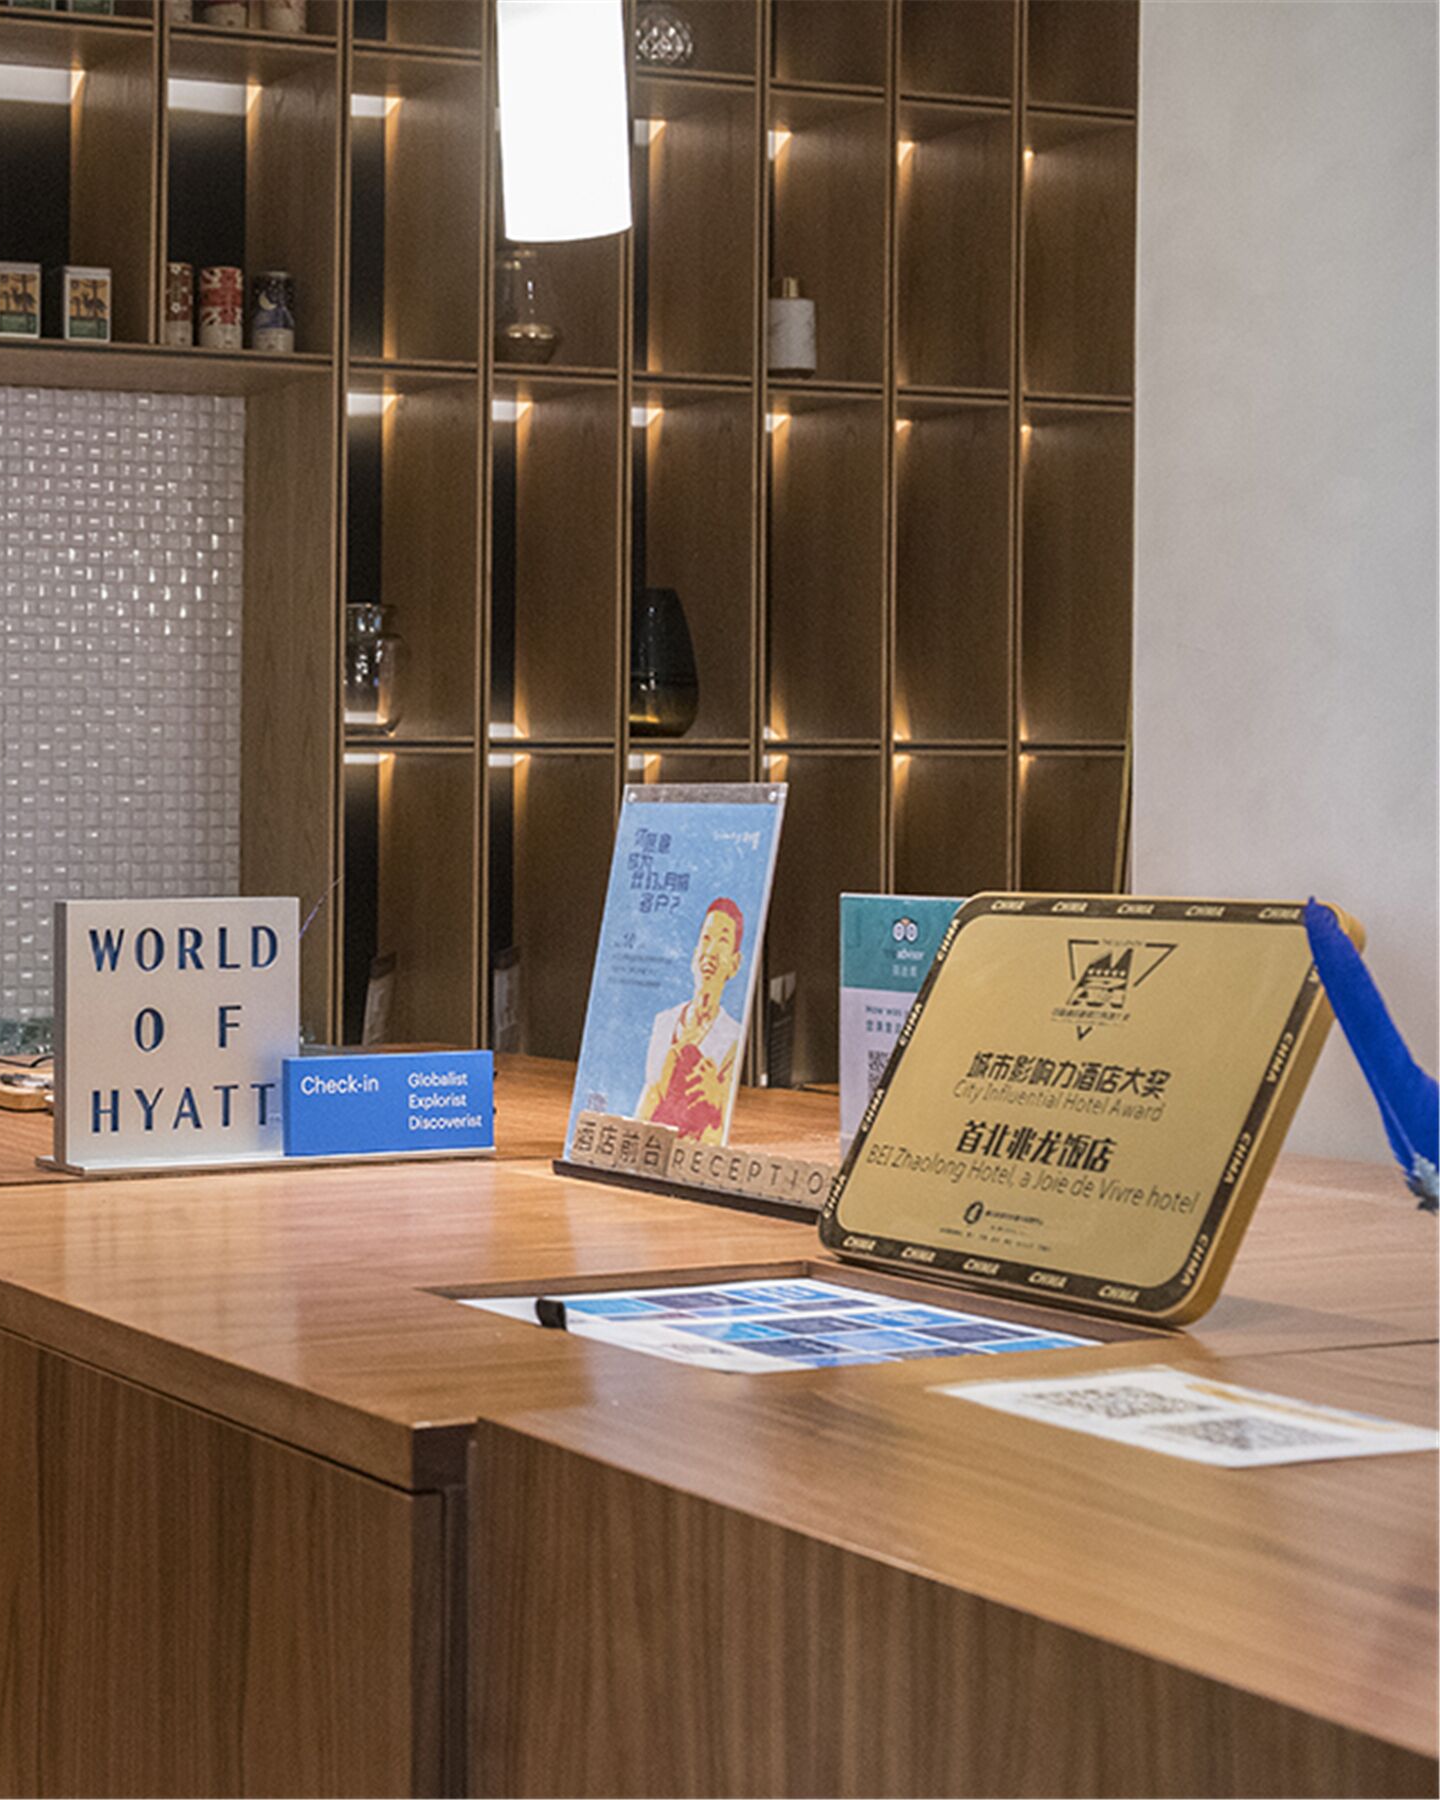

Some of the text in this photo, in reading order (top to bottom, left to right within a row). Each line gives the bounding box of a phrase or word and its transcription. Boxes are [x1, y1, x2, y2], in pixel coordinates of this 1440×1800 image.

[89, 926, 278, 972] WORLD
[134, 1005, 242, 1052] OF
[300, 1074, 380, 1095] Check-in
[407, 1072, 468, 1088] Globalist
[967, 1051, 1171, 1099] 城市影响力酒店大奖
[92, 1084, 275, 1133] HYATT
[408, 1093, 467, 1110] Explorist
[408, 1113, 482, 1130] Discoverist
[953, 1079, 1167, 1122] City Influential Hotel Award
[577, 1120, 836, 1195] 酒店前台 RECEPTIO
[956, 1120, 1118, 1172] 首北兆龙饭店
[891, 1147, 967, 1183] Zhaolong
[1019, 1171, 1032, 1188] a
[1032, 1170, 1069, 1194] Joie
[1070, 1175, 1094, 1198] de
[1098, 1177, 1145, 1206] Vivre
[1146, 1185, 1201, 1214] hotel
